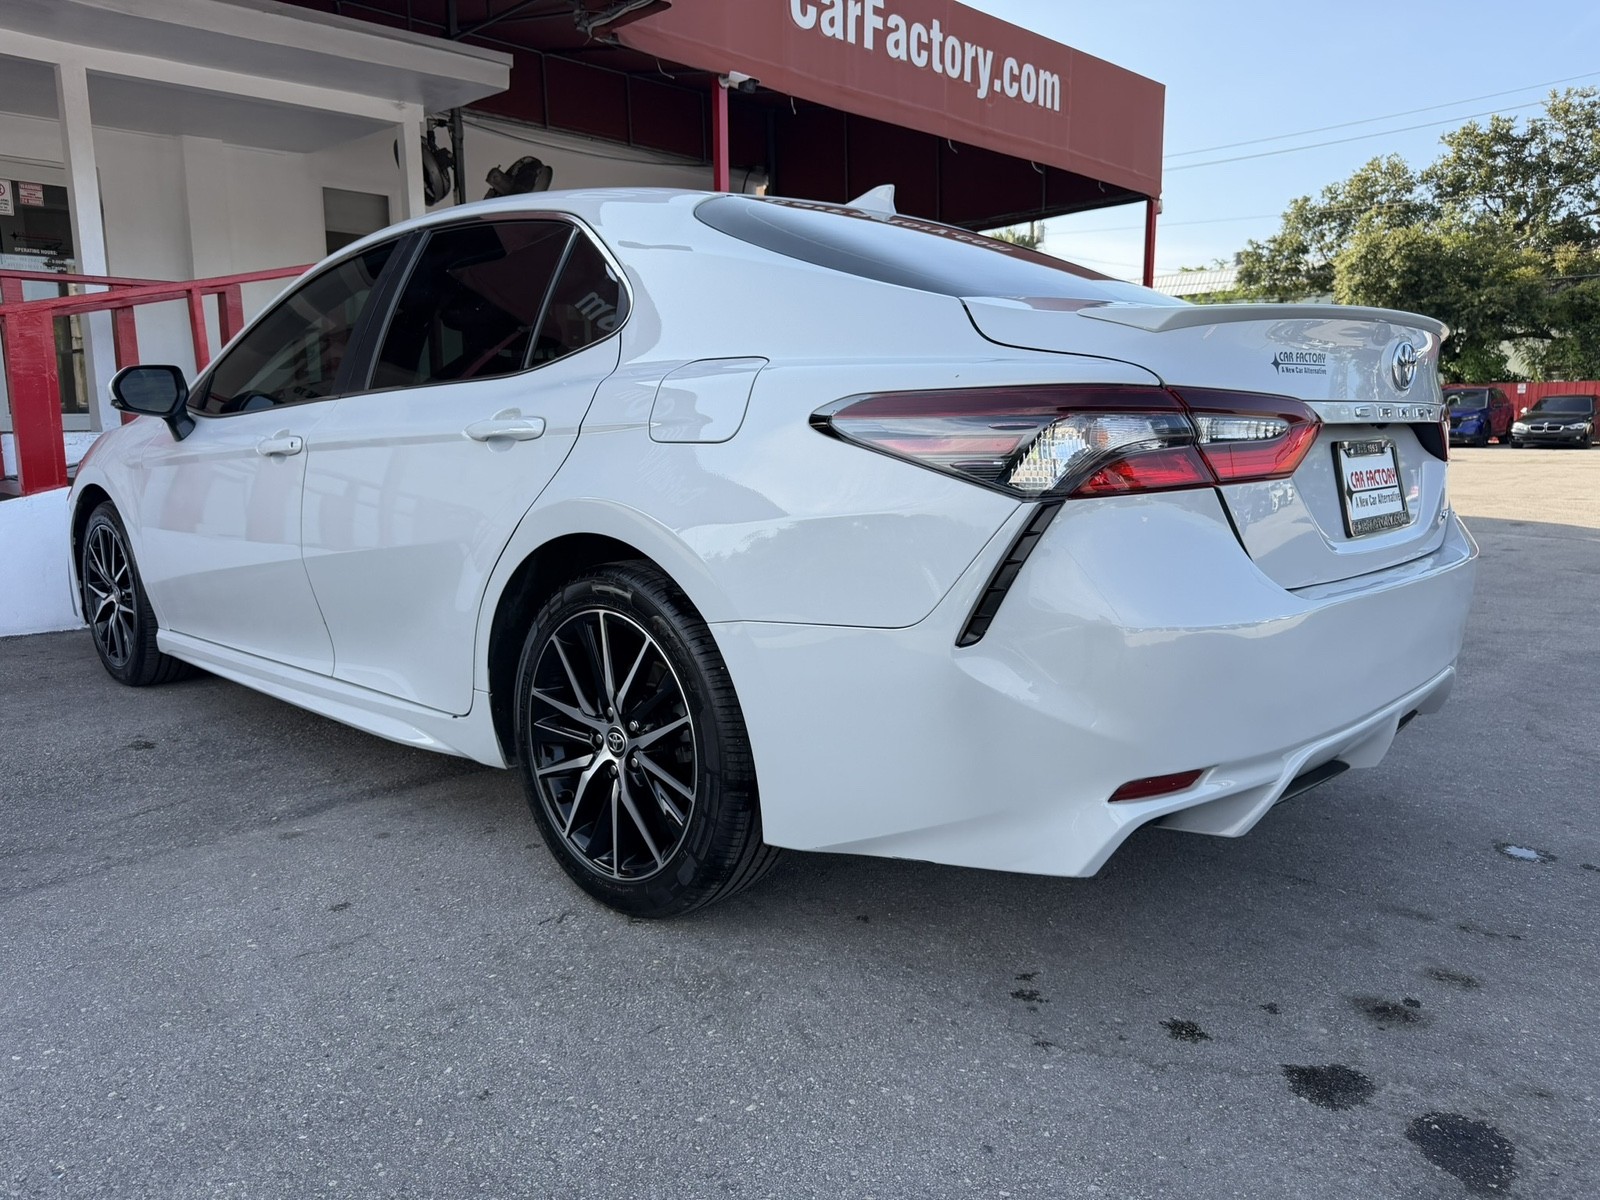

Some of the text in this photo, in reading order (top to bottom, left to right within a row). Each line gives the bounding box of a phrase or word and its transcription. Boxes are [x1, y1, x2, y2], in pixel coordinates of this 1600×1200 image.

[791, 0, 1061, 112] CarFactory.com
[1279, 351, 1326, 364] CAR FACTORY
[1295, 366, 1303, 374] Car
[1303, 367, 1327, 375] Alternative
[1350, 467, 1396, 489] CAR FACTORY
[1355, 490, 1401, 508] A New Car Alternative
